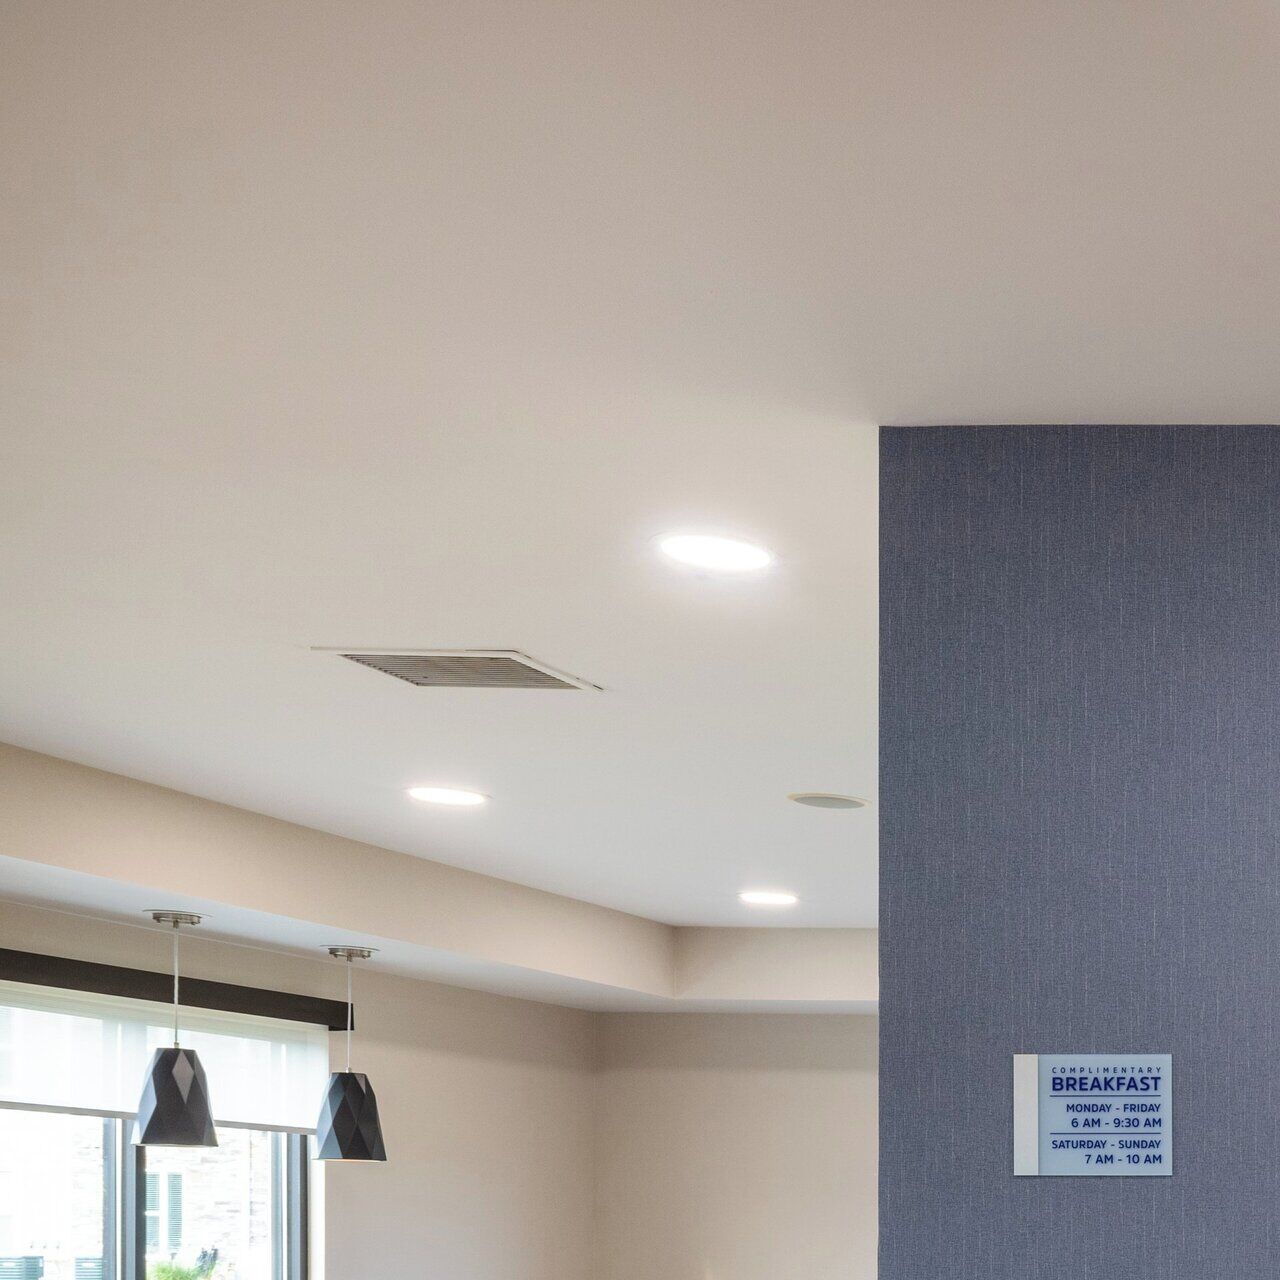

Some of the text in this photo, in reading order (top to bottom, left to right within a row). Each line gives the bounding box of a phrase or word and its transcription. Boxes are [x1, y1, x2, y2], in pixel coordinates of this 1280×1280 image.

[1052, 1076, 1161, 1092] BREAKFAST
[1066, 1103, 1112, 1113] MONDAY
[1123, 1103, 1161, 1113] FRIDAY
[1071, 1118, 1079, 1128] 6
[1082, 1118, 1101, 1128] AM
[1113, 1118, 1140, 1128] 9:30
[1143, 1118, 1162, 1128] AM
[1051, 1140, 1107, 1149] SATURDAY
[1118, 1140, 1161, 1149] SUNDAY
[1085, 1154, 1091, 1164] 7
[1095, 1154, 1114, 1164] AM
[1126, 1154, 1140, 1164] 10
[1144, 1154, 1162, 1164] AM
